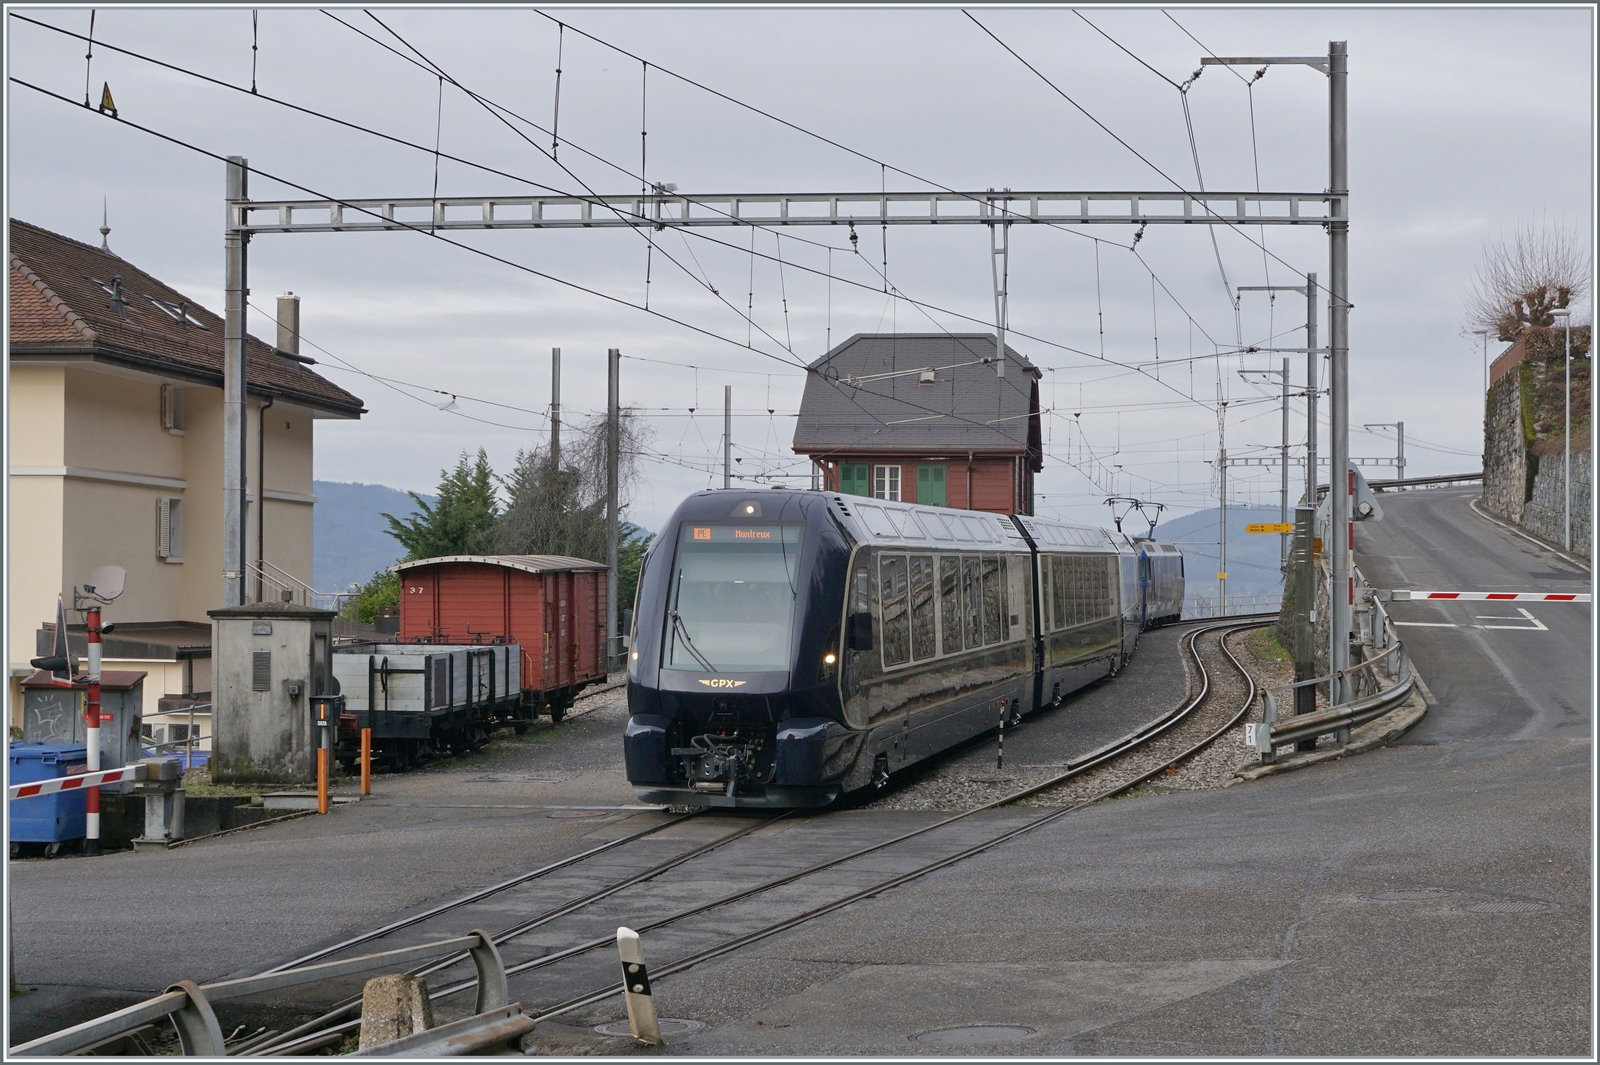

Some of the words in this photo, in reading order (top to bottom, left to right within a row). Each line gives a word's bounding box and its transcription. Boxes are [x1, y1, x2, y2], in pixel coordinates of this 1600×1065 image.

[697, 529, 707, 538] PE
[735, 529, 771, 539] Montreux
[710, 679, 734, 688] GPX
[1247, 725, 1253, 734] 7
